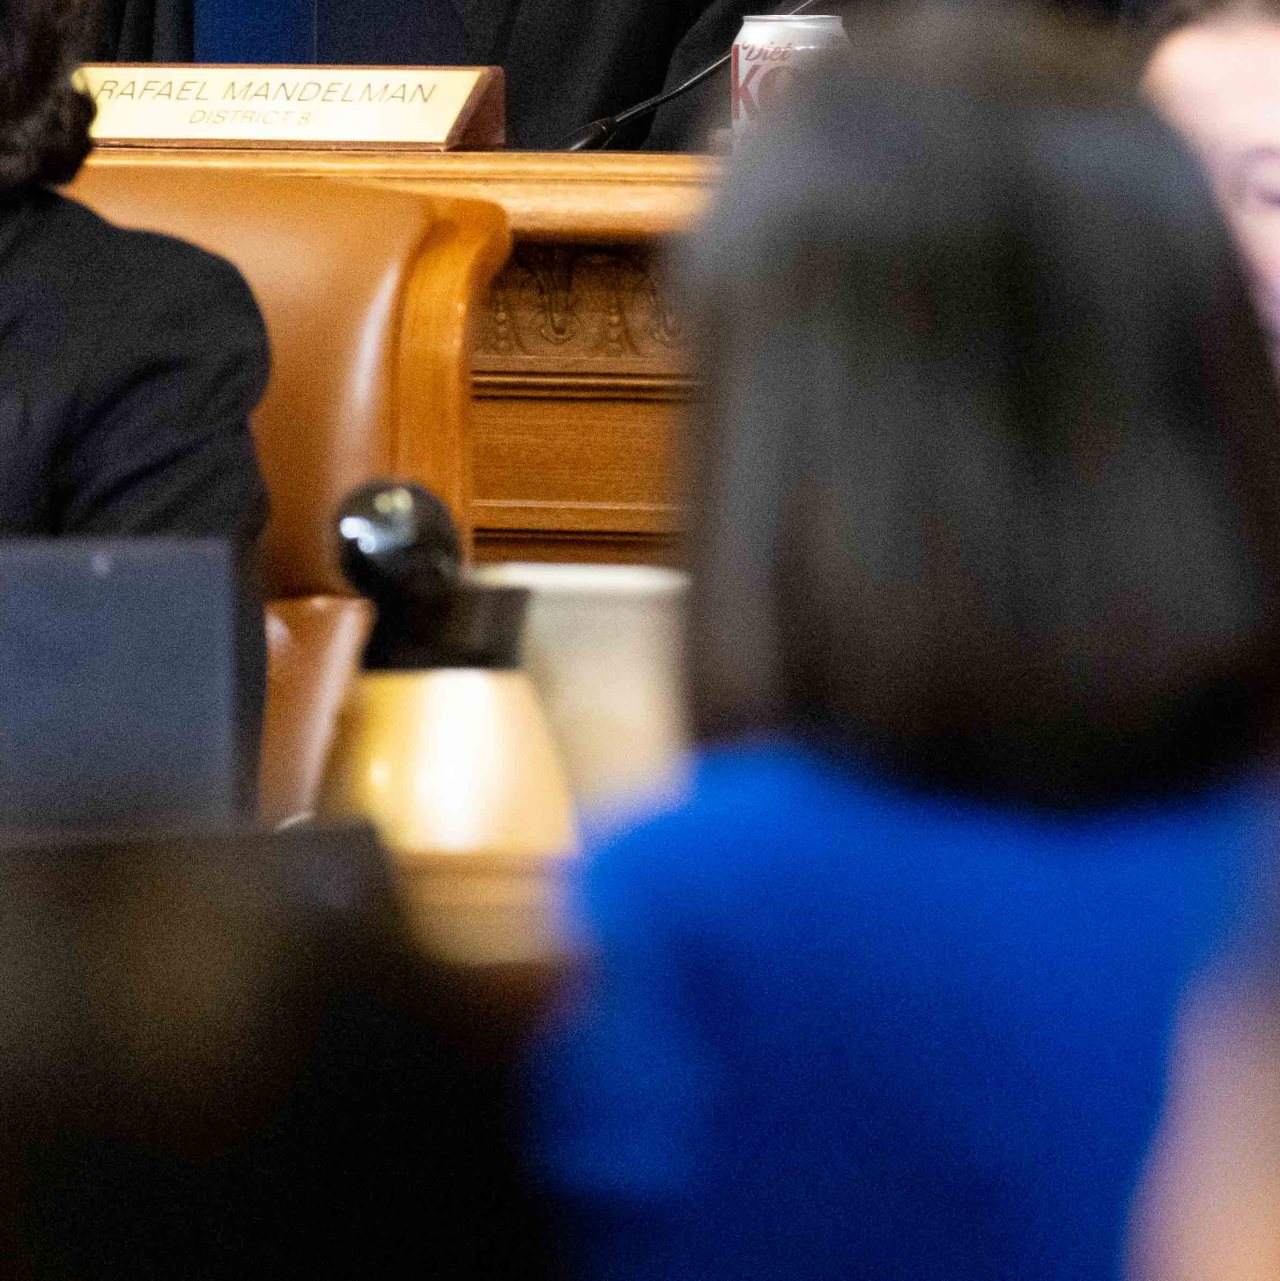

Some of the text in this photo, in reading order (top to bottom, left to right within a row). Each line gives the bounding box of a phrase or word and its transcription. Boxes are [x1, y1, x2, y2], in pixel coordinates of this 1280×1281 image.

[742, 41, 793, 62] Diet
[96, 79, 437, 104] RAFAEL MANDELMAN
[188, 108, 294, 125] DISTRICT
